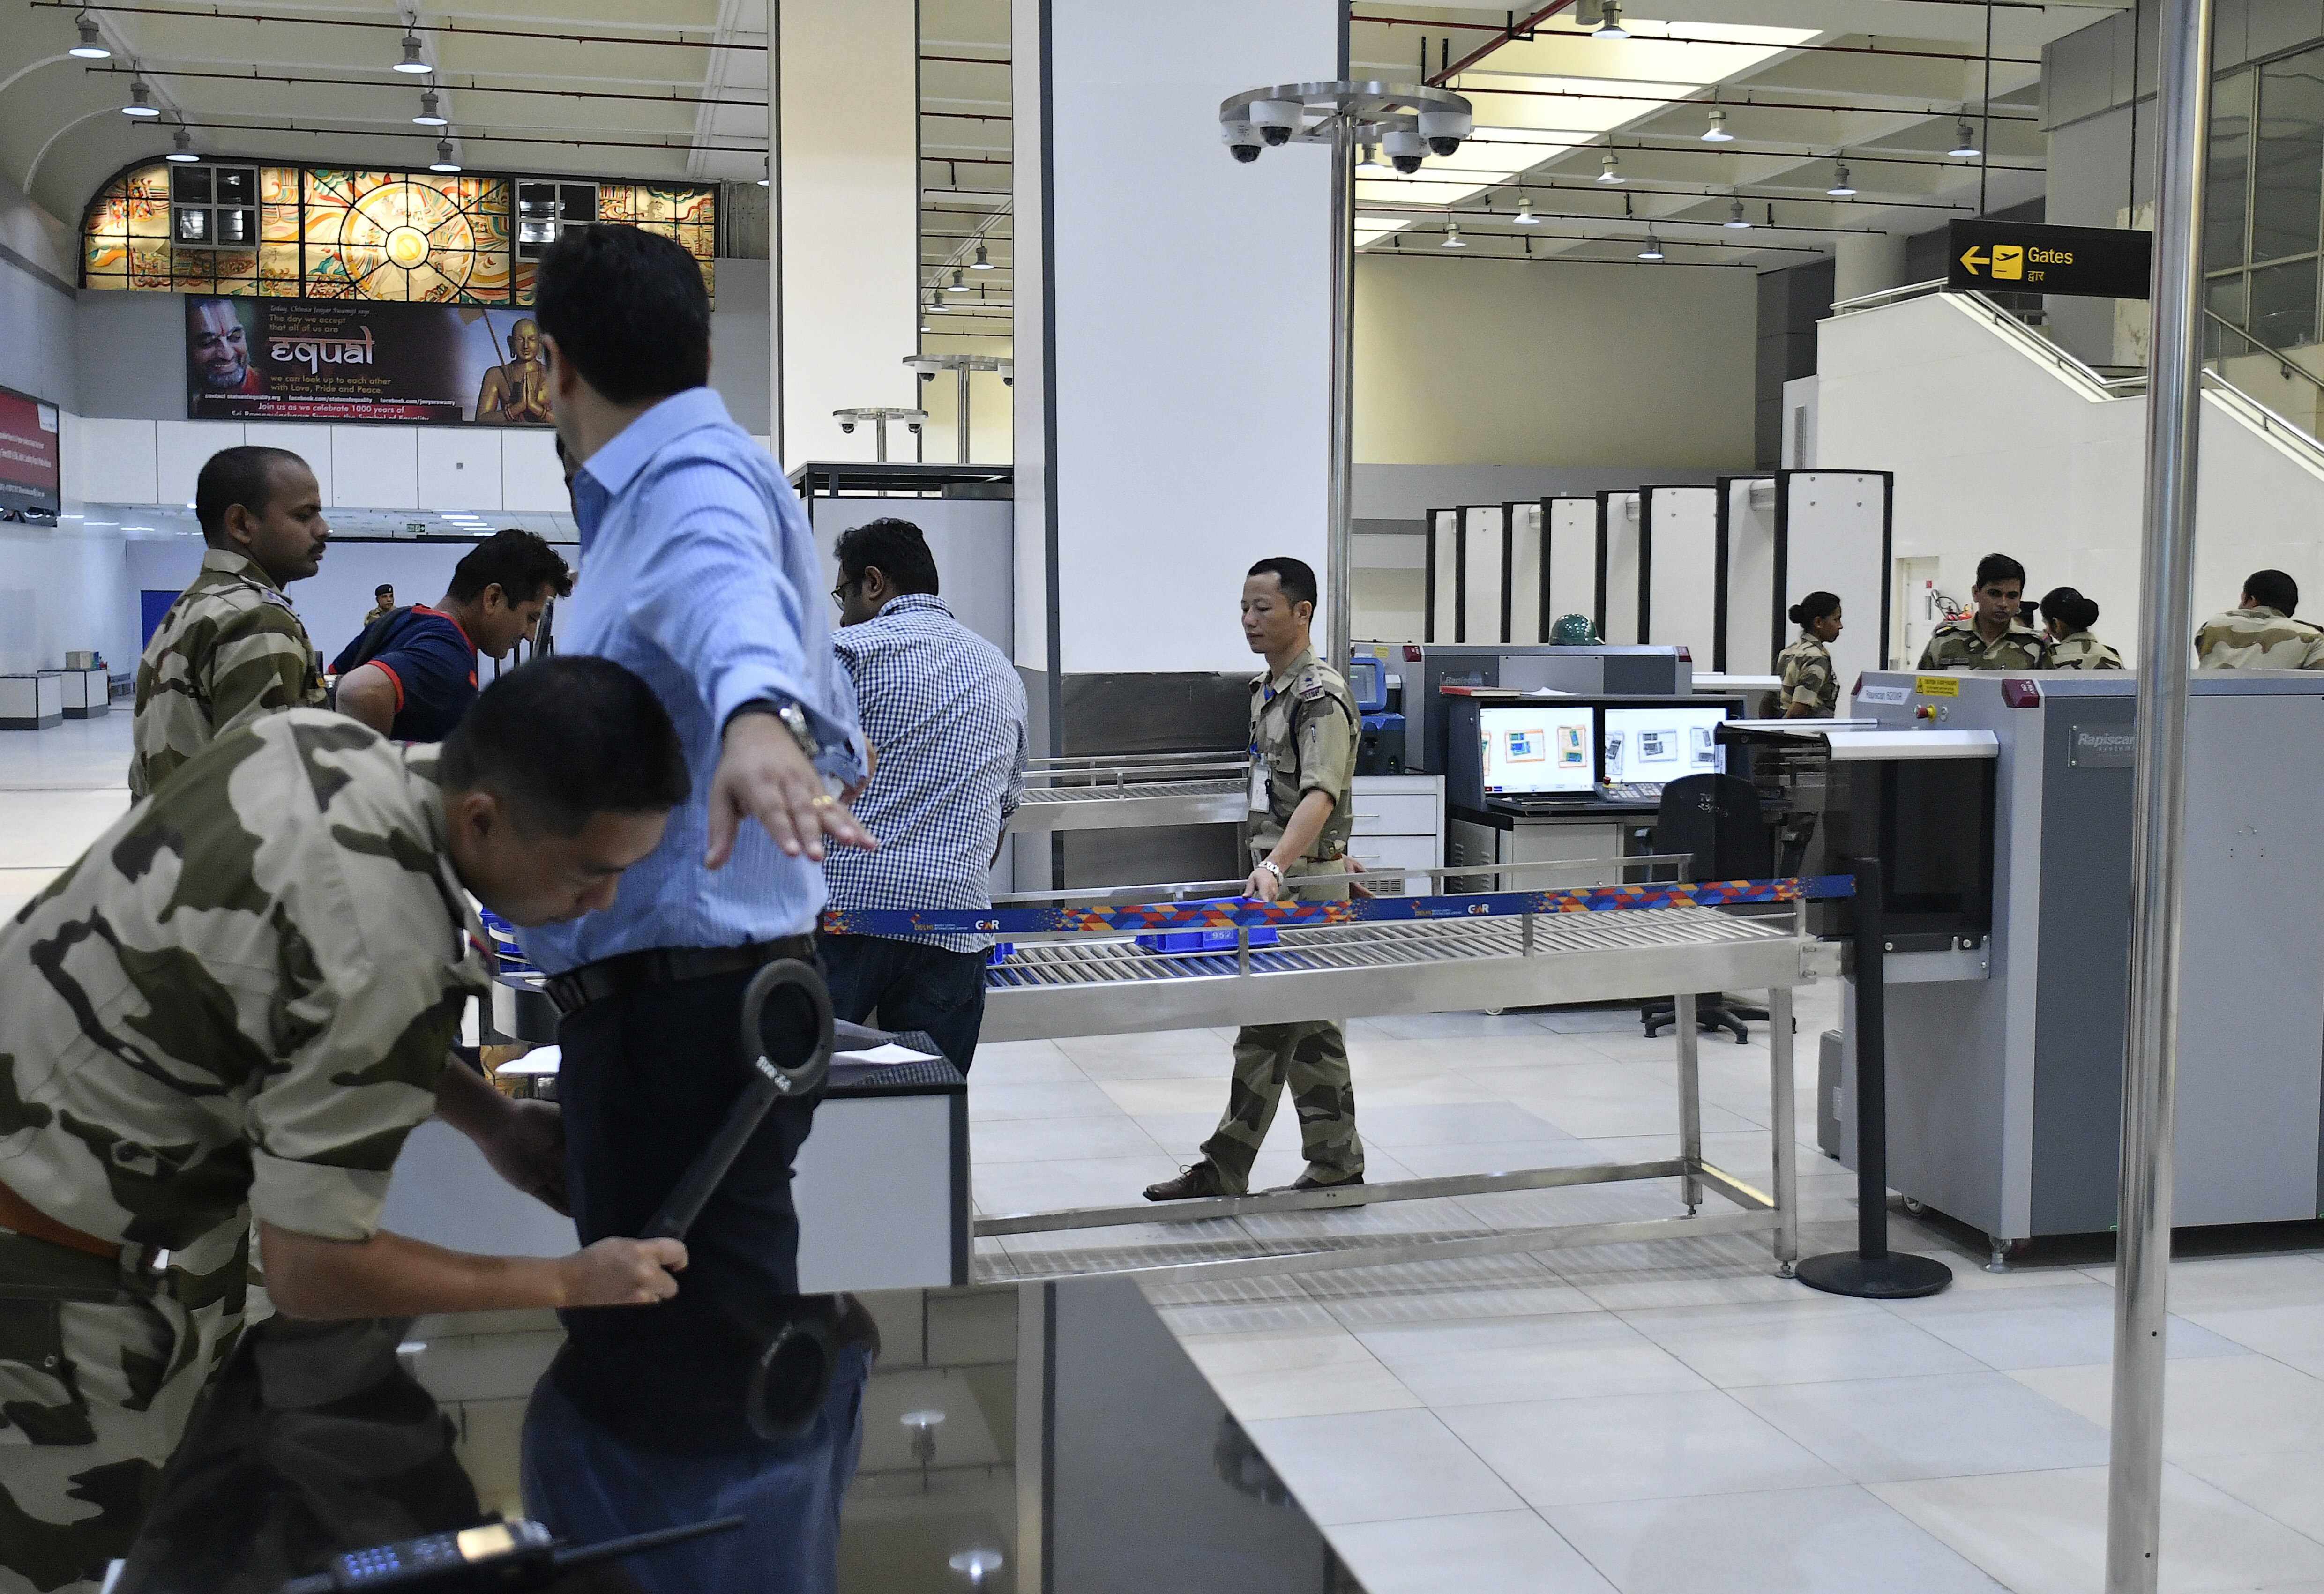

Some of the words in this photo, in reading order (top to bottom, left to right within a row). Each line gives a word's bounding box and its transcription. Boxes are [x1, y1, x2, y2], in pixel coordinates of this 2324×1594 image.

[2028, 246, 2073, 265] Gates
[2027, 270, 2045, 282] द्वार
[287, 315, 302, 325] day
[291, 384, 313, 393] Love,
